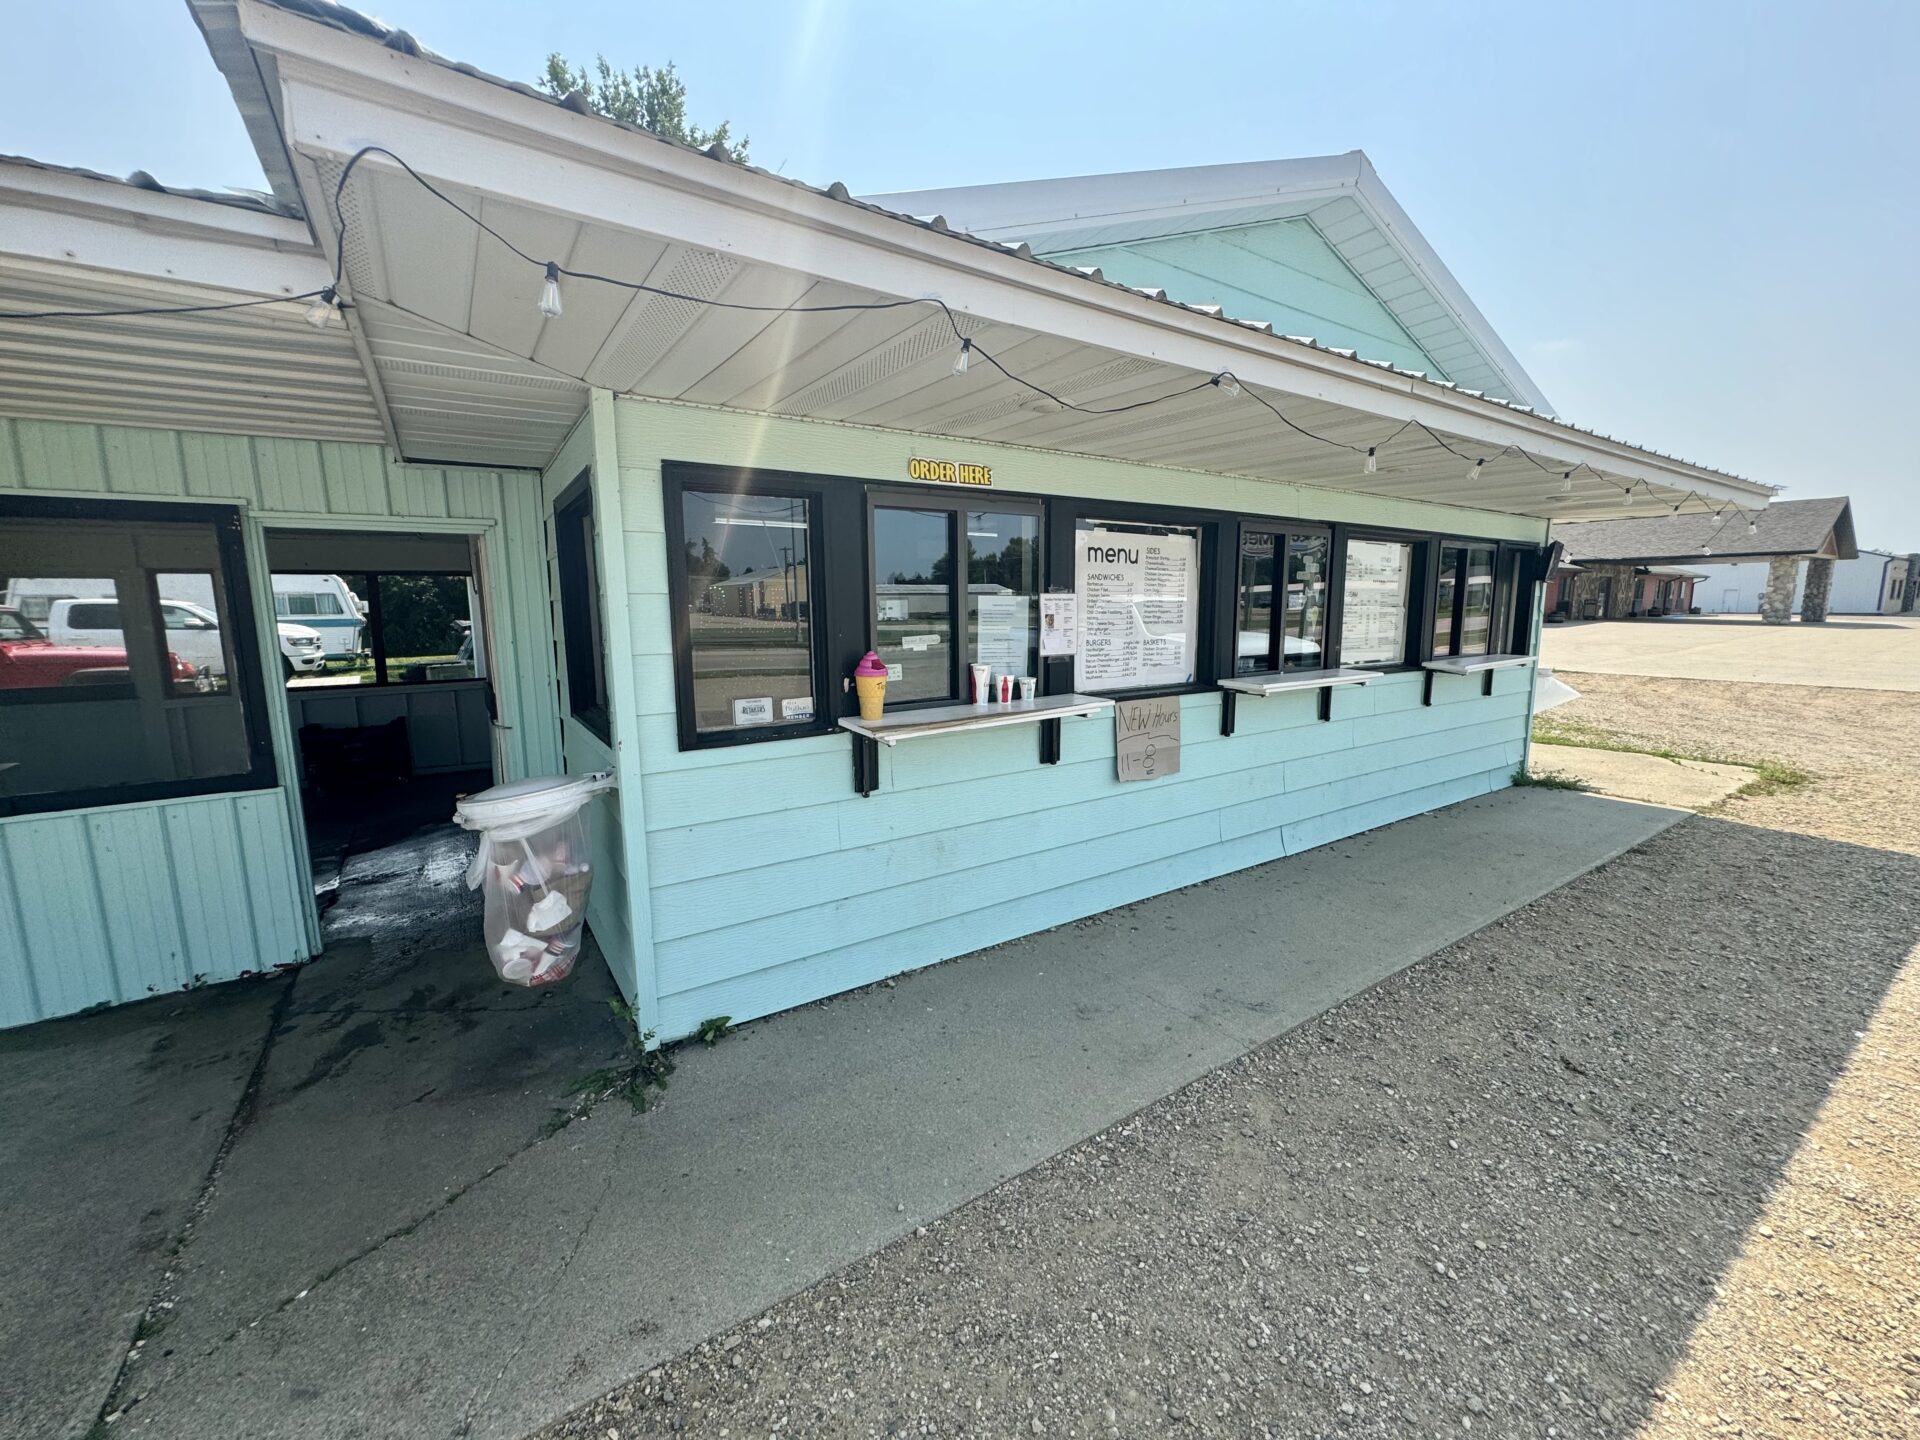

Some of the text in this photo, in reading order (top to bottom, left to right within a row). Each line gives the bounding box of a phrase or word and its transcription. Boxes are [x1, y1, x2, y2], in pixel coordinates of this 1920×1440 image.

[910, 457, 992, 486] ORDER HERE
[1087, 545, 1139, 565] menu
[1146, 546, 1161, 555] SIDES
[1087, 573, 1125, 581] SANDWICHES
[1085, 638, 1111, 647] BURGERS
[1143, 638, 1167, 646] BASKETS
[1118, 703, 1179, 733] NEW Hours
